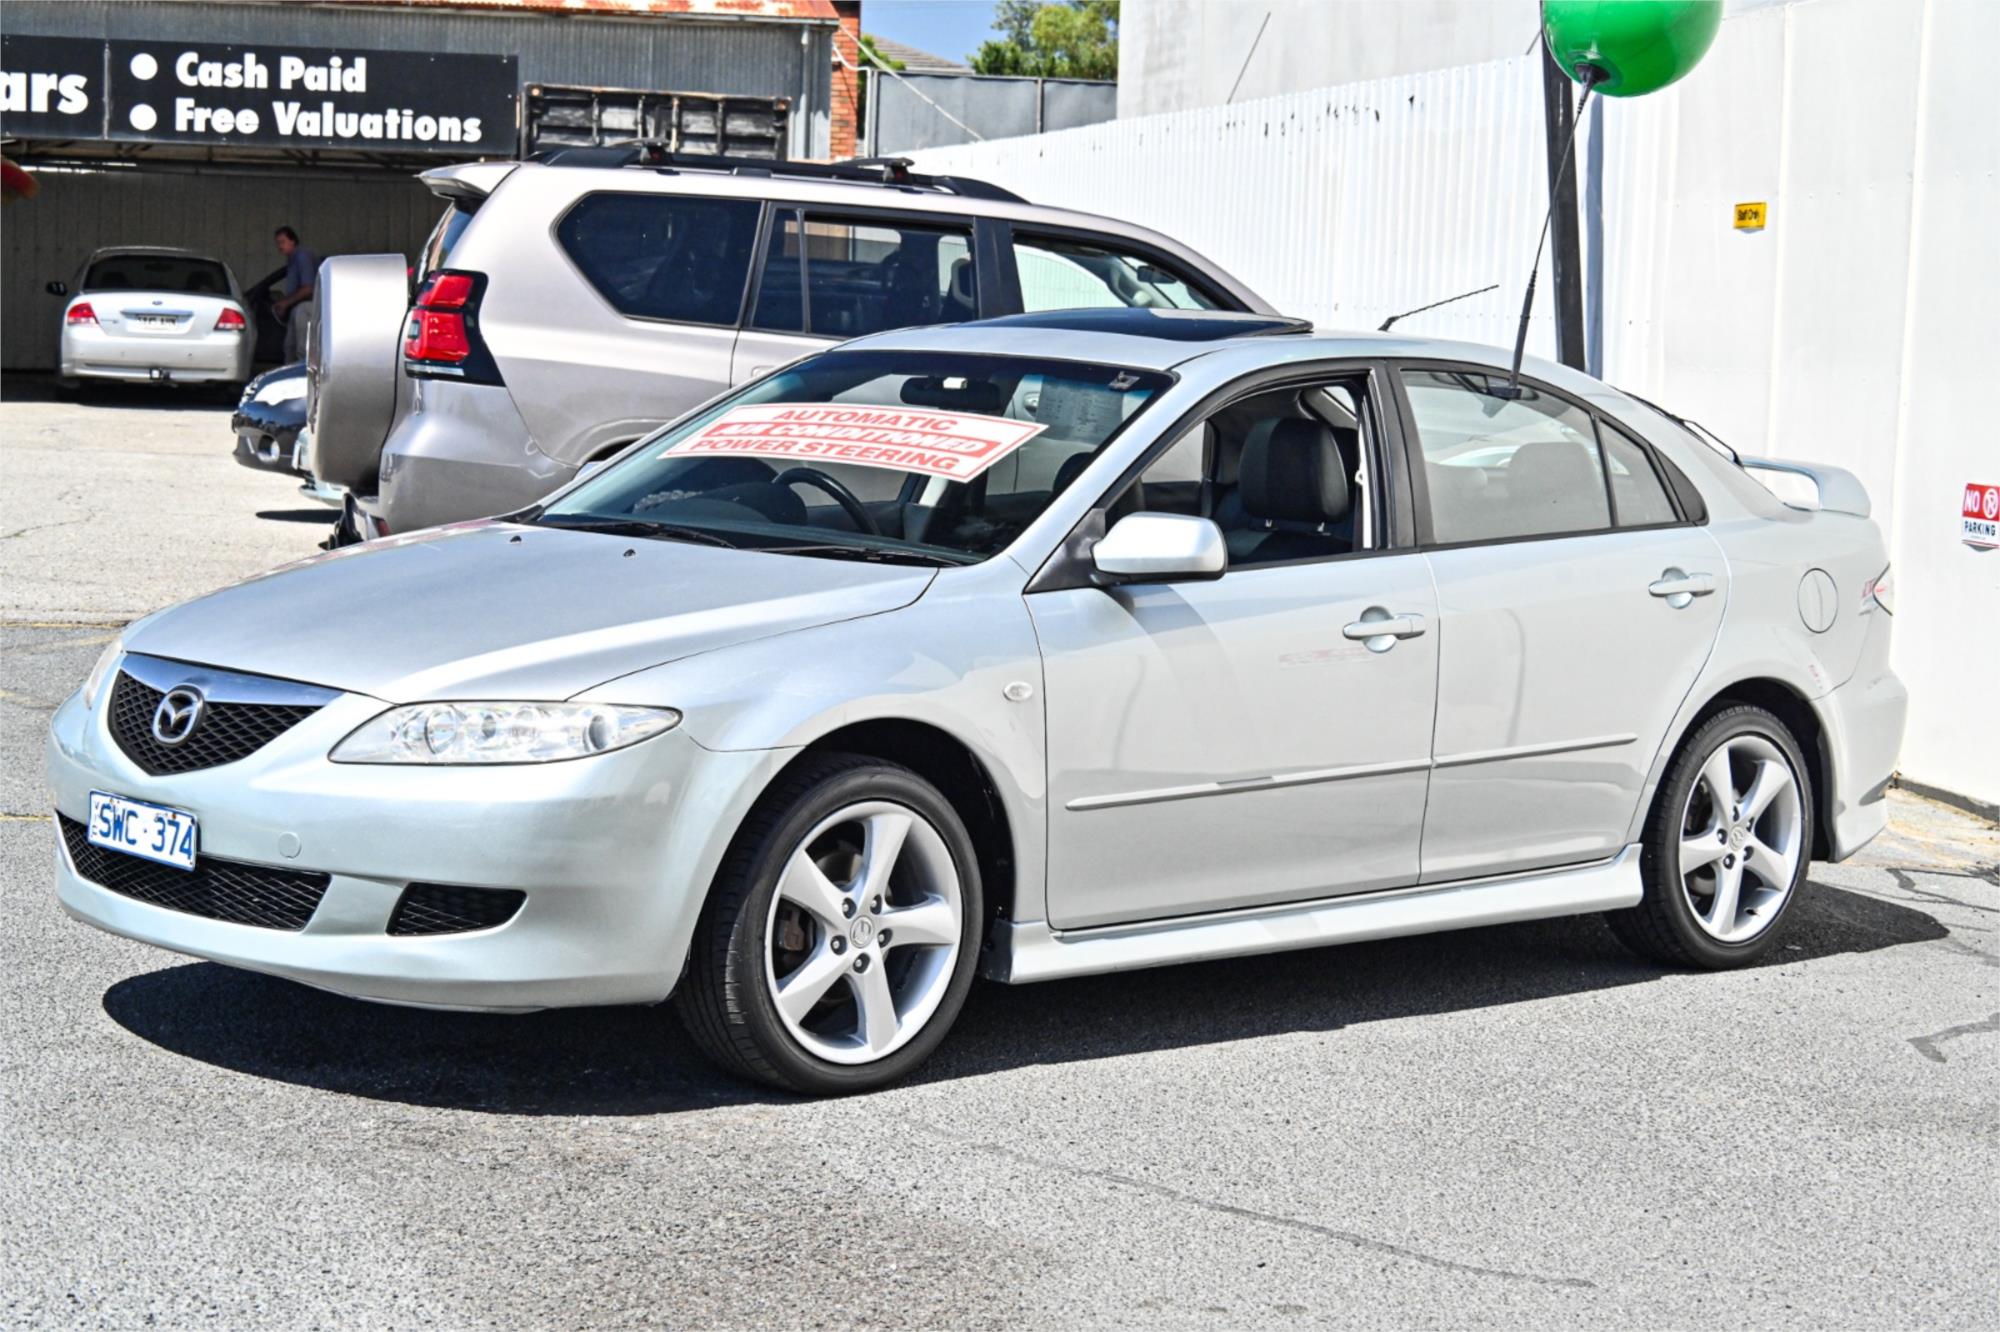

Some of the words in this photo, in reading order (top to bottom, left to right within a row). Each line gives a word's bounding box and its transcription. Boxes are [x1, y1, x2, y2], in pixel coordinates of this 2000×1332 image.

[175, 51, 268, 89] Cash
[280, 56, 367, 93] Paid
[0, 71, 89, 115] ars
[175, 97, 259, 134] Free
[273, 100, 482, 143] Valuations
[773, 410, 958, 431] AUTOMATIC
[690, 439, 799, 452] POWER
[798, 442, 960, 470] STEERING
[767, 424, 987, 455] CONDITIONED
[1964, 489, 1980, 513] NO
[1964, 520, 1996, 537] PARKING
[151, 816, 193, 860] 374
